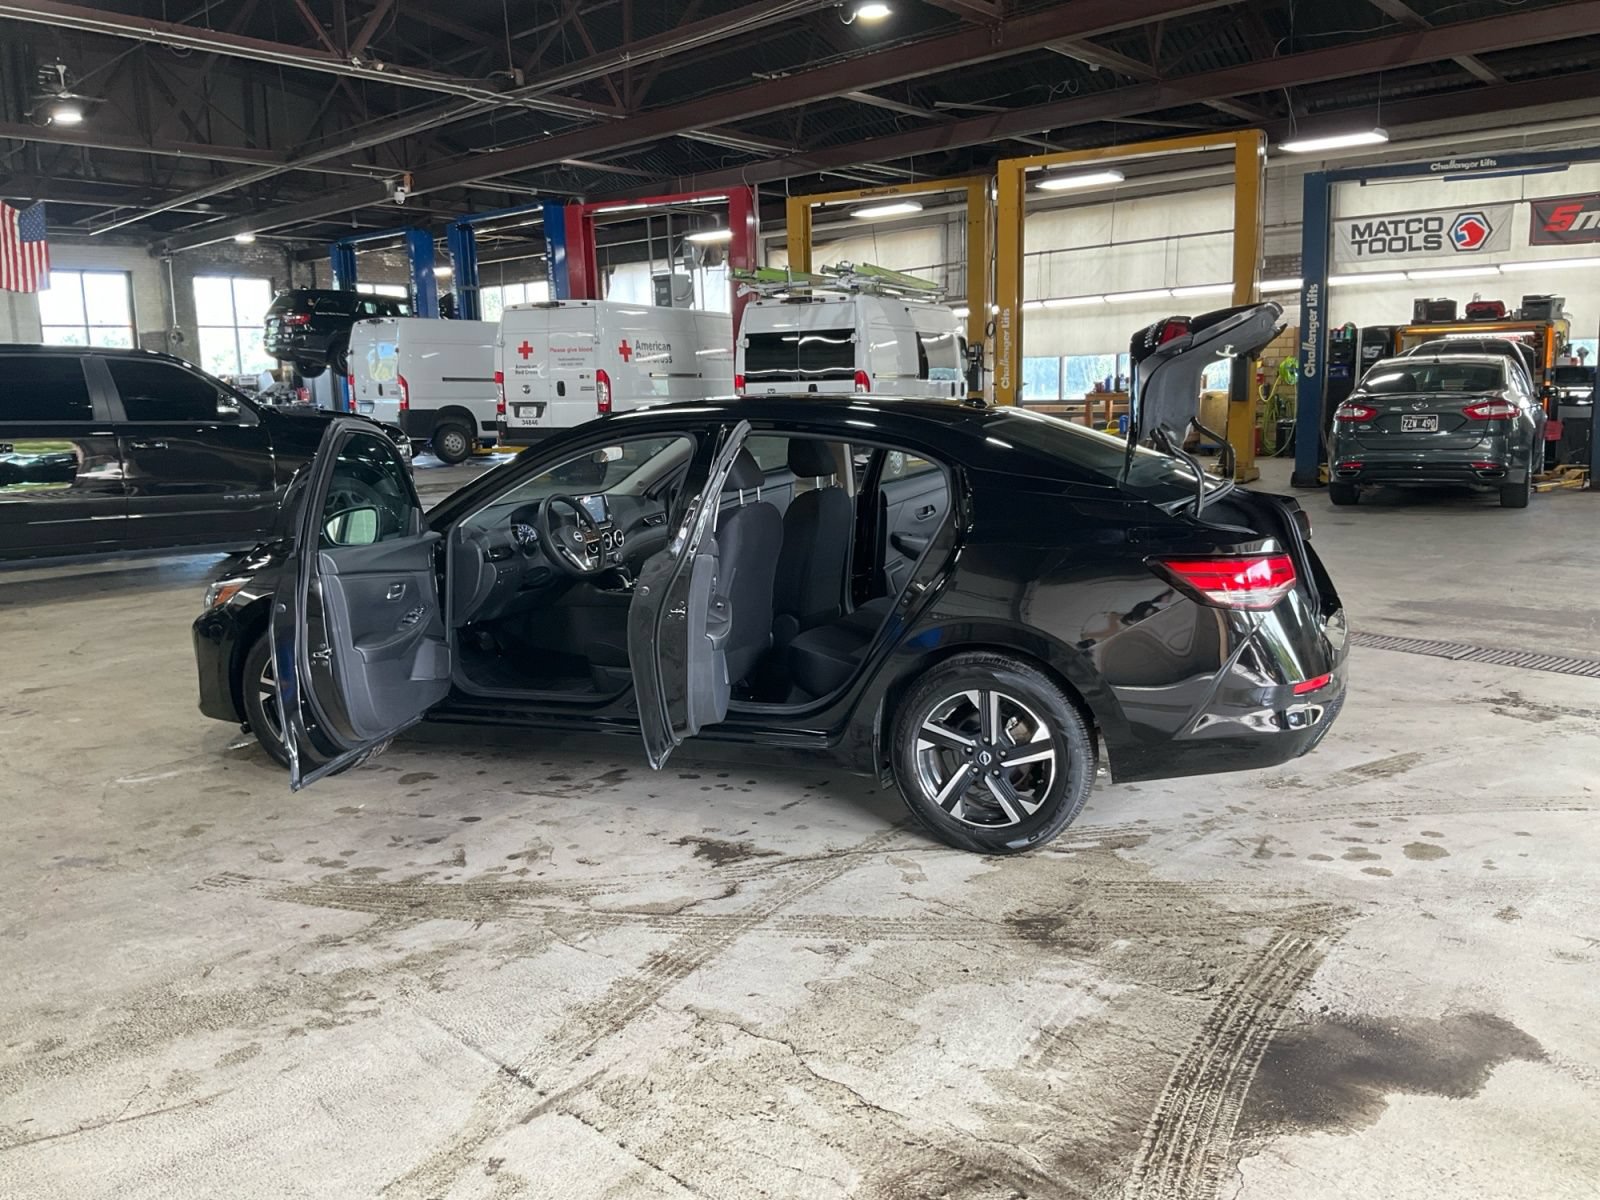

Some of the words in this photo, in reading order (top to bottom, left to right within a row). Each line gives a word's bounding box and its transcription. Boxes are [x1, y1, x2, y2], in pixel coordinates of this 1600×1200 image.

[1430, 160, 1479, 170] Challenger
[1351, 216, 1443, 240] MATCO
[1543, 204, 1600, 232] Sn
[1351, 233, 1443, 256] TOOLS
[1306, 283, 1319, 307] Lifts
[635, 339, 672, 351] American
[1302, 308, 1319, 378] Challenger
[1000, 330, 1011, 389] Challenger
